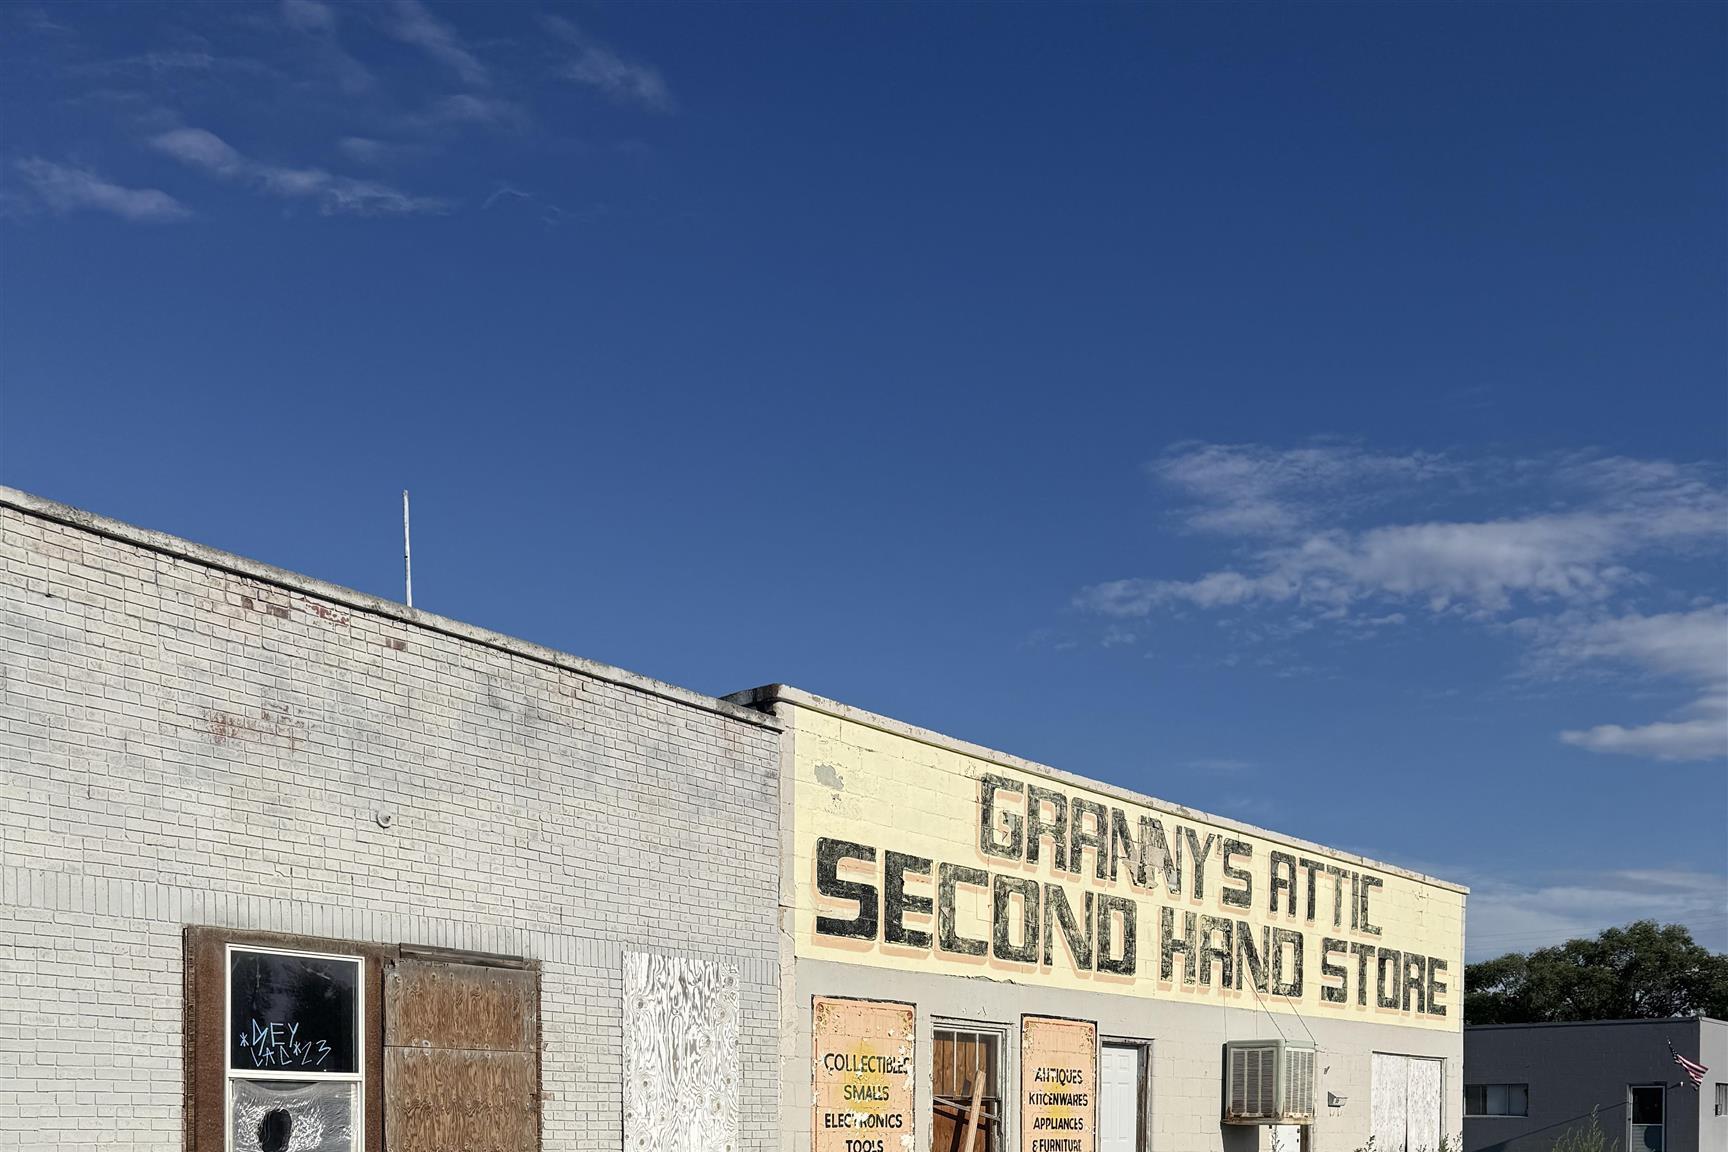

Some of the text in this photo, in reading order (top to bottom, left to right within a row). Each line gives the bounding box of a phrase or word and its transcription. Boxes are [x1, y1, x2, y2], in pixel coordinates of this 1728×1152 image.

[981, 772, 1383, 936] GRANNY'S ATTIC
[816, 836, 1448, 1016] SECOND HAND STORE
[1034, 1067, 1084, 1086] ANTIQUES
[844, 1085, 890, 1101] SMALLS
[1033, 1116, 1084, 1130] APPLIANCES
